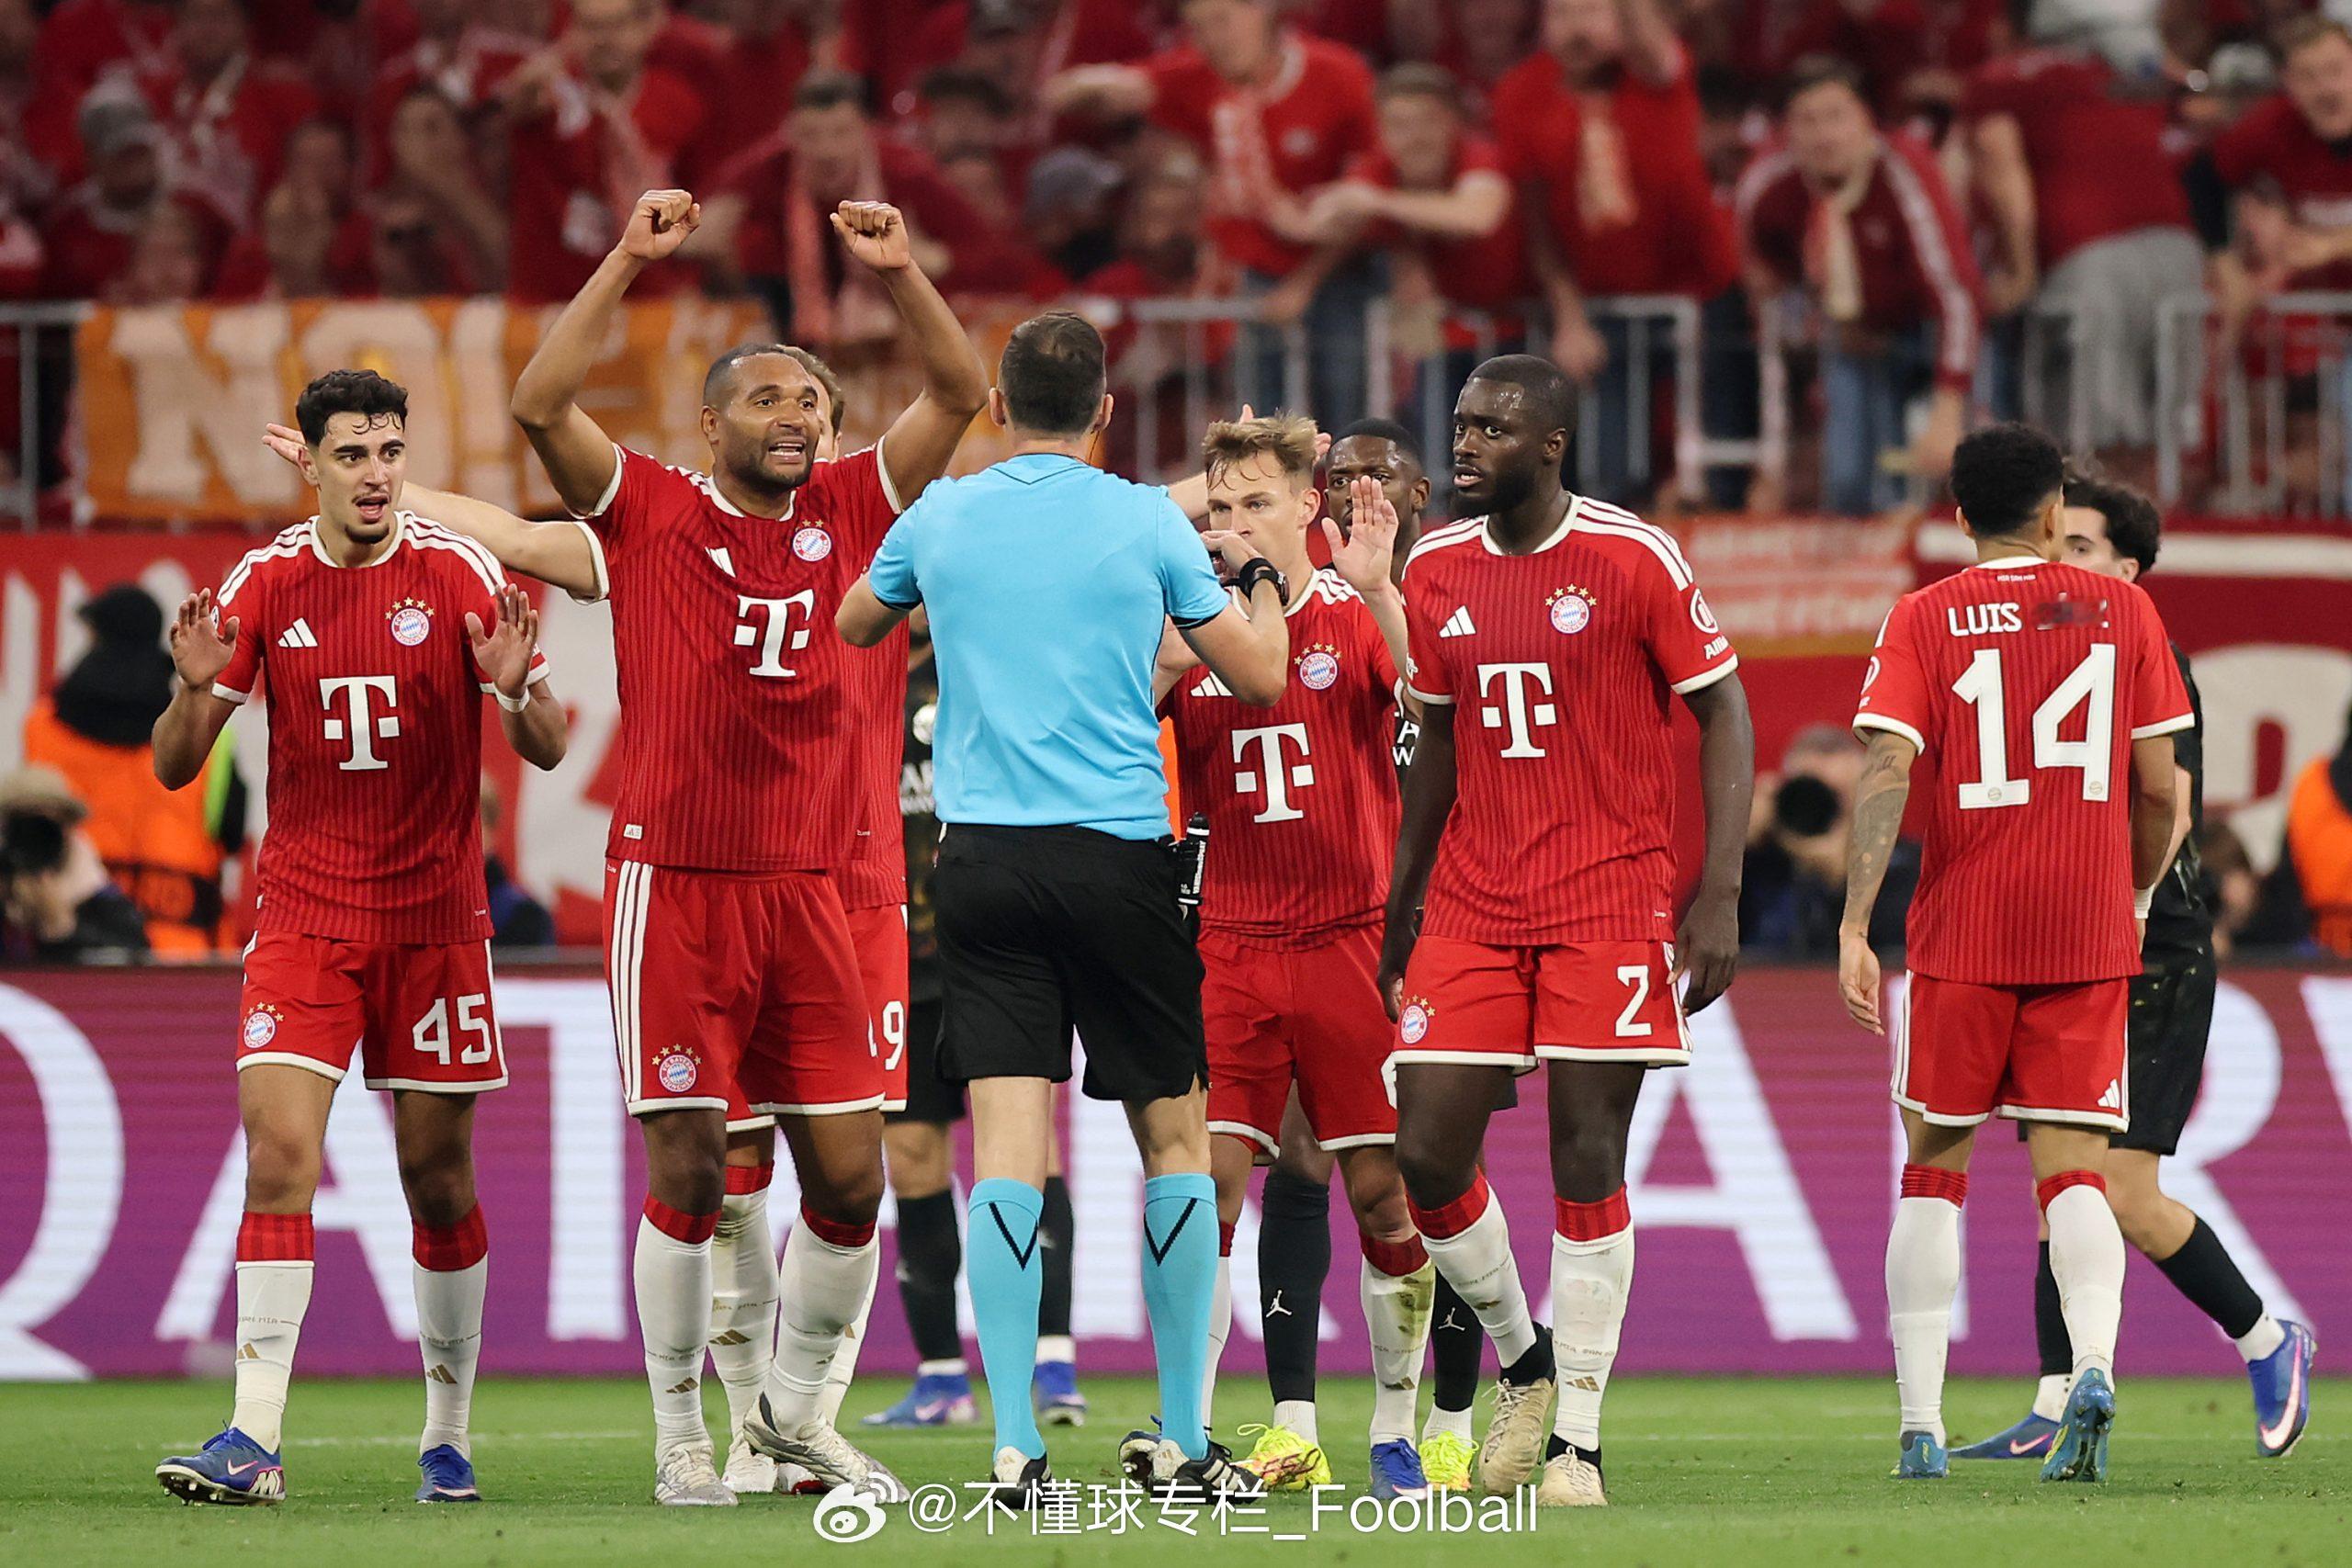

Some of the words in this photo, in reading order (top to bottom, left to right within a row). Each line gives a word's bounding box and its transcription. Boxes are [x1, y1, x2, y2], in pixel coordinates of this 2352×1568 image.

[1948, 602, 2023, 637] LUIS
[319, 675, 401, 771] T
[1477, 662, 1556, 758] T
[1951, 643, 2116, 809] 14
[1232, 723, 1314, 823] T
[413, 993, 492, 1065] 45
[1615, 964, 1653, 1037] 2
